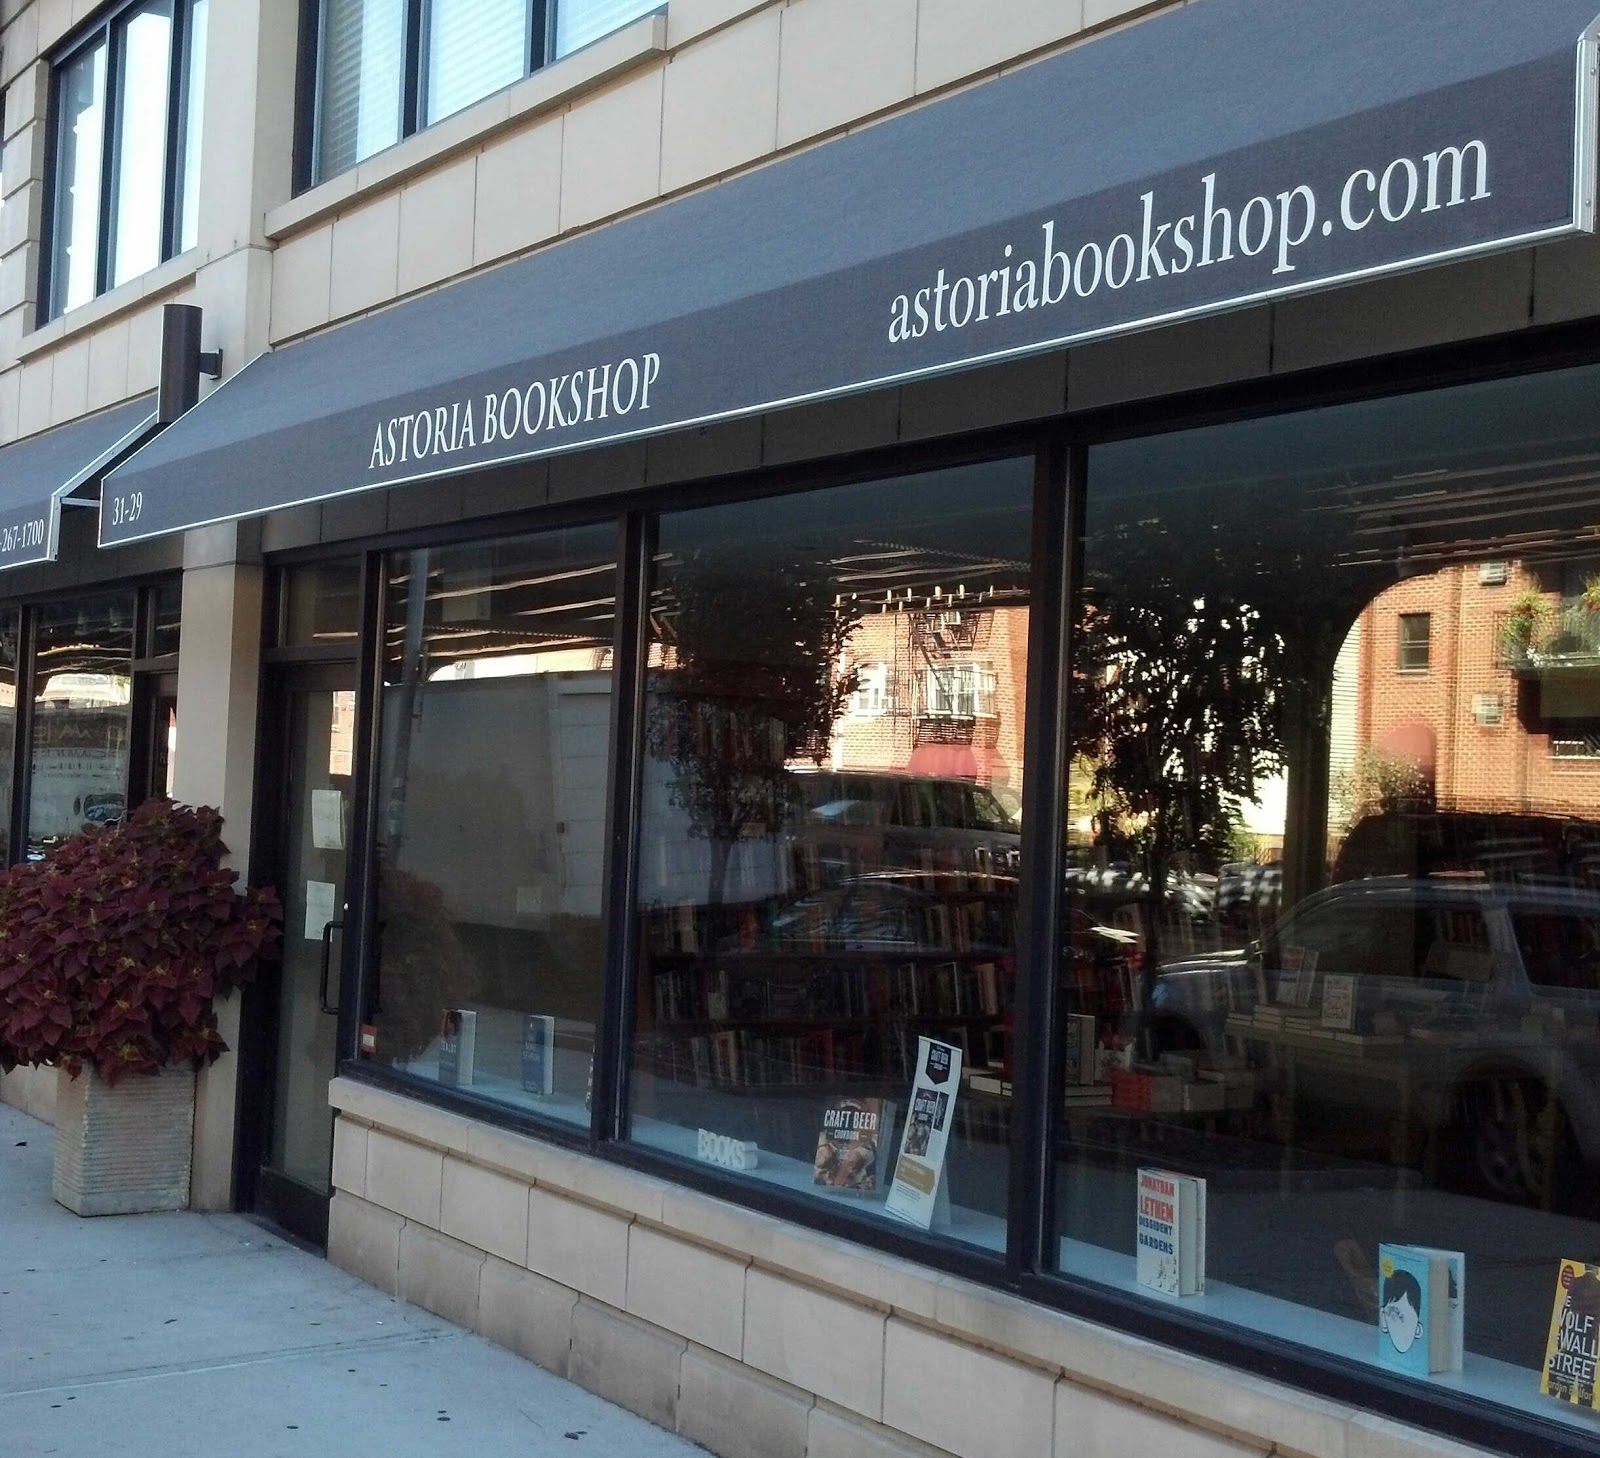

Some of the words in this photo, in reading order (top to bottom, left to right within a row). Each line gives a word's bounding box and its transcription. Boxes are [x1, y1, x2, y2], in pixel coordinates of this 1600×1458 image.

[888, 140, 1491, 343] astoriabookshop.com
[368, 400, 476, 469] ASTORIA
[481, 352, 660, 444] BOOKSHOP
[112, 491, 143, 526] 31-29
[823, 1109, 851, 1128] CRAFT
[853, 1111, 877, 1130] BEER
[697, 1128, 747, 1170] BOOKS
[1139, 1233, 1174, 1255] GARDENS
[1560, 1329, 1599, 1359] WALL
